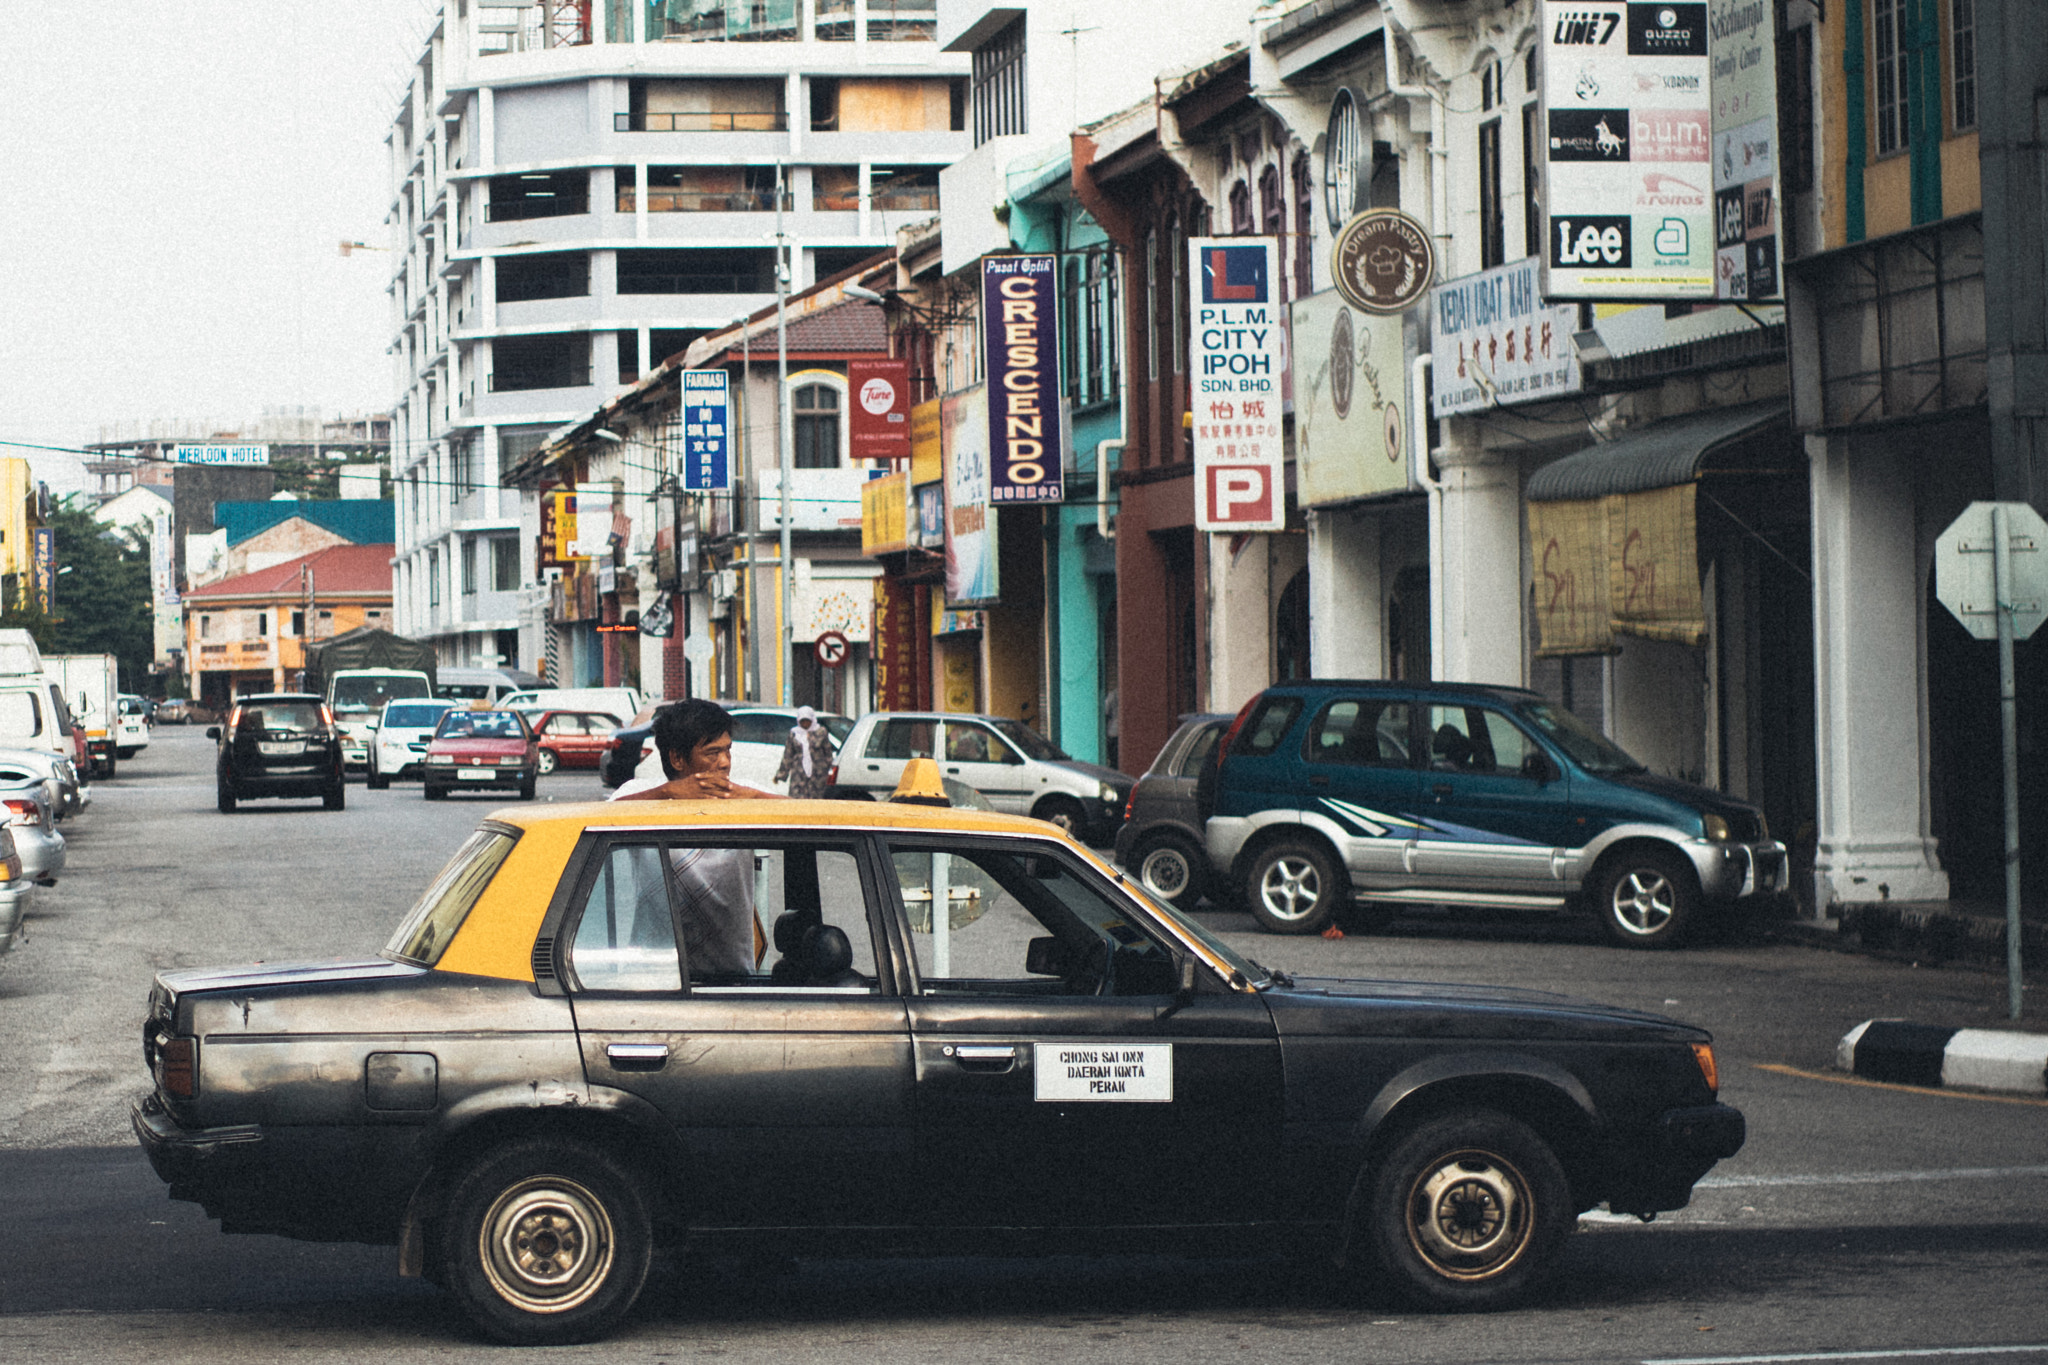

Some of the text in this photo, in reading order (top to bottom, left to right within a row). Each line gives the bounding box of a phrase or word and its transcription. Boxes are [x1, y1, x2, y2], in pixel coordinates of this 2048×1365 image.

[1553, 12, 1621, 45] LINE 7
[1663, 75, 1700, 89] SCORPION
[1719, 198, 1742, 242] Lee
[1345, 218, 1424, 255] Dream Pastry
[1559, 220, 1622, 264] Lee
[986, 258, 1052, 276] Pusat Optik
[1211, 250, 1256, 299] L
[1729, 273, 1747, 297] RPG
[1439, 267, 1533, 336] KEDAI UBAT KAH
[1200, 308, 1274, 325] P.L.M.
[1202, 329, 1268, 350] CITY
[1203, 353, 1270, 375] IPOH
[1000, 276, 1045, 485] CRESCENDO
[1201, 378, 1274, 393] SDN. BHD.
[864, 387, 892, 404] Tune
[178, 447, 265, 464] MERLOON HOTEL
[1216, 469, 1263, 519] P
[1059, 1051, 1098, 1063] CHONG
[1102, 1051, 1119, 1063] SAI
[1067, 1065, 1145, 1078] DAERAH KINTA
[1089, 1080, 1126, 1093] PERAK
